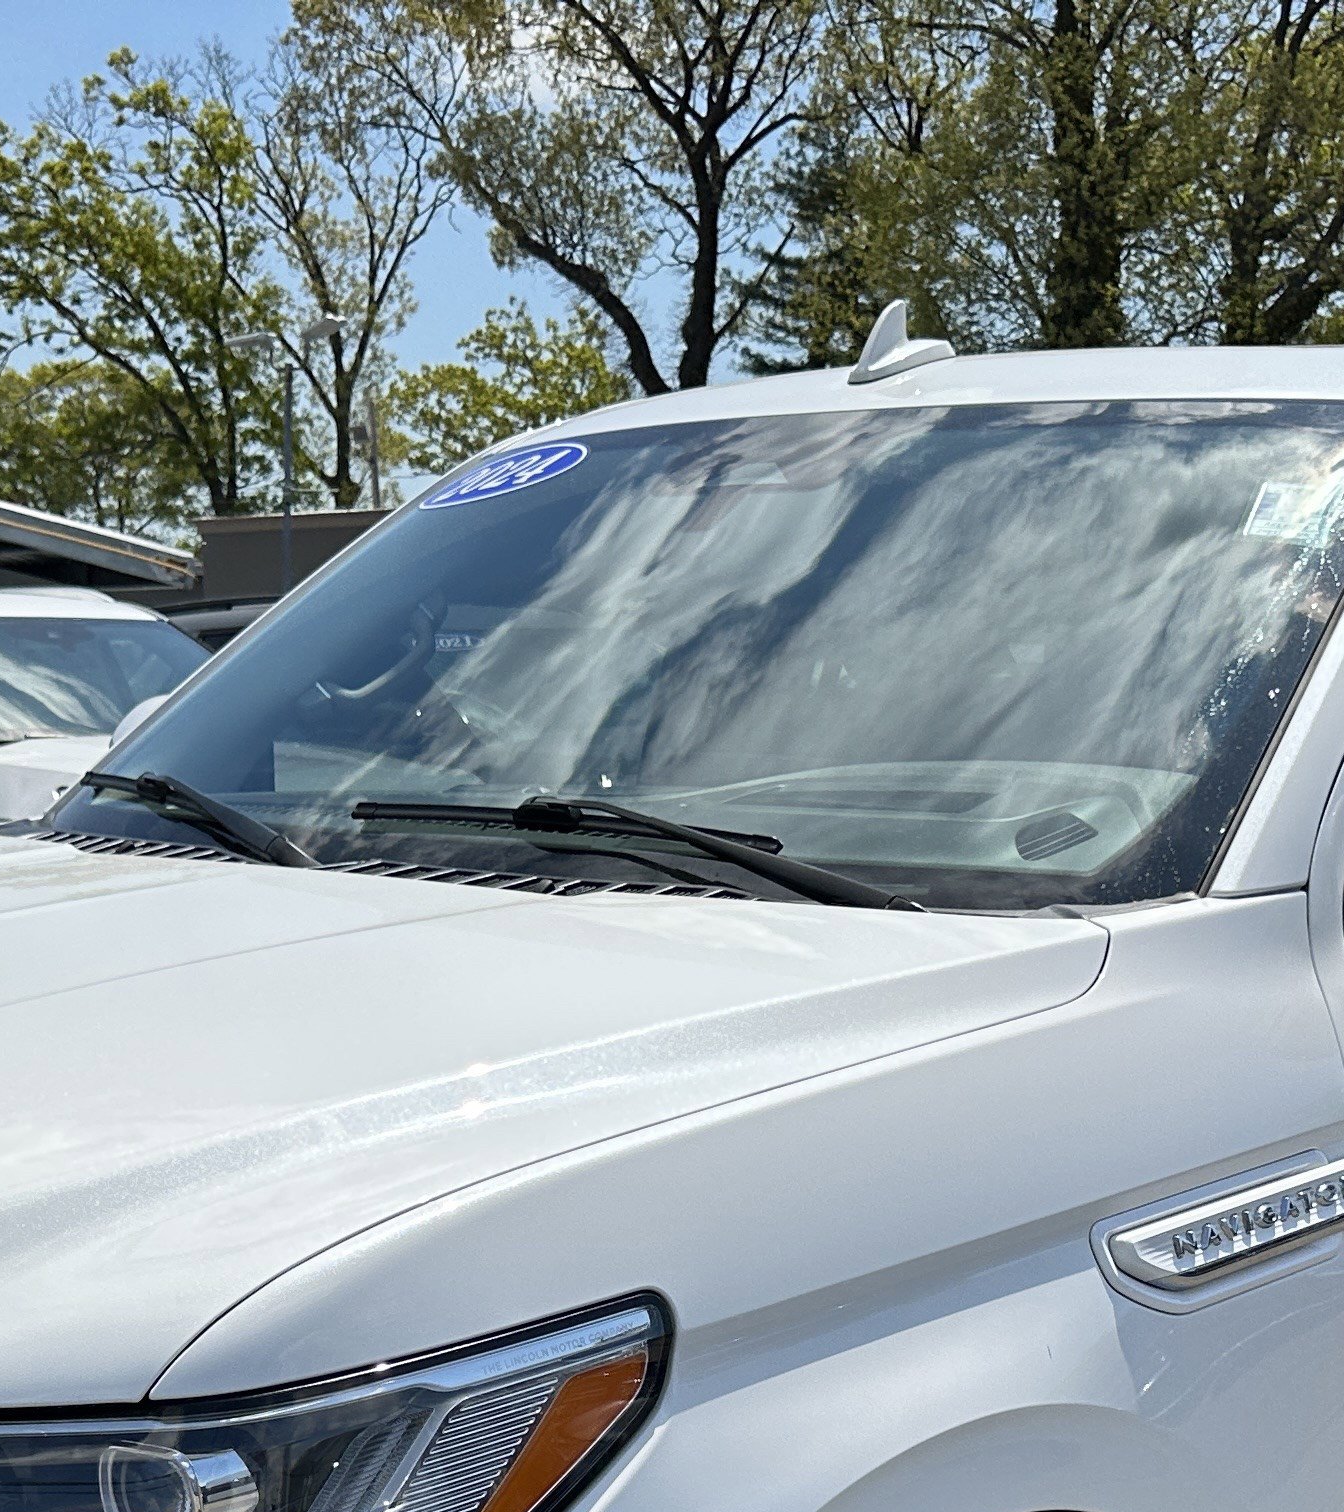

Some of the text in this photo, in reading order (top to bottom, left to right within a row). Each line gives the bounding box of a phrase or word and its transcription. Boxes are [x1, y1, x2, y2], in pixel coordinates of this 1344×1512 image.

[432, 449, 572, 503] 2024
[481, 1322, 634, 1375] THE LINCOLN MOTOR COMPANY
